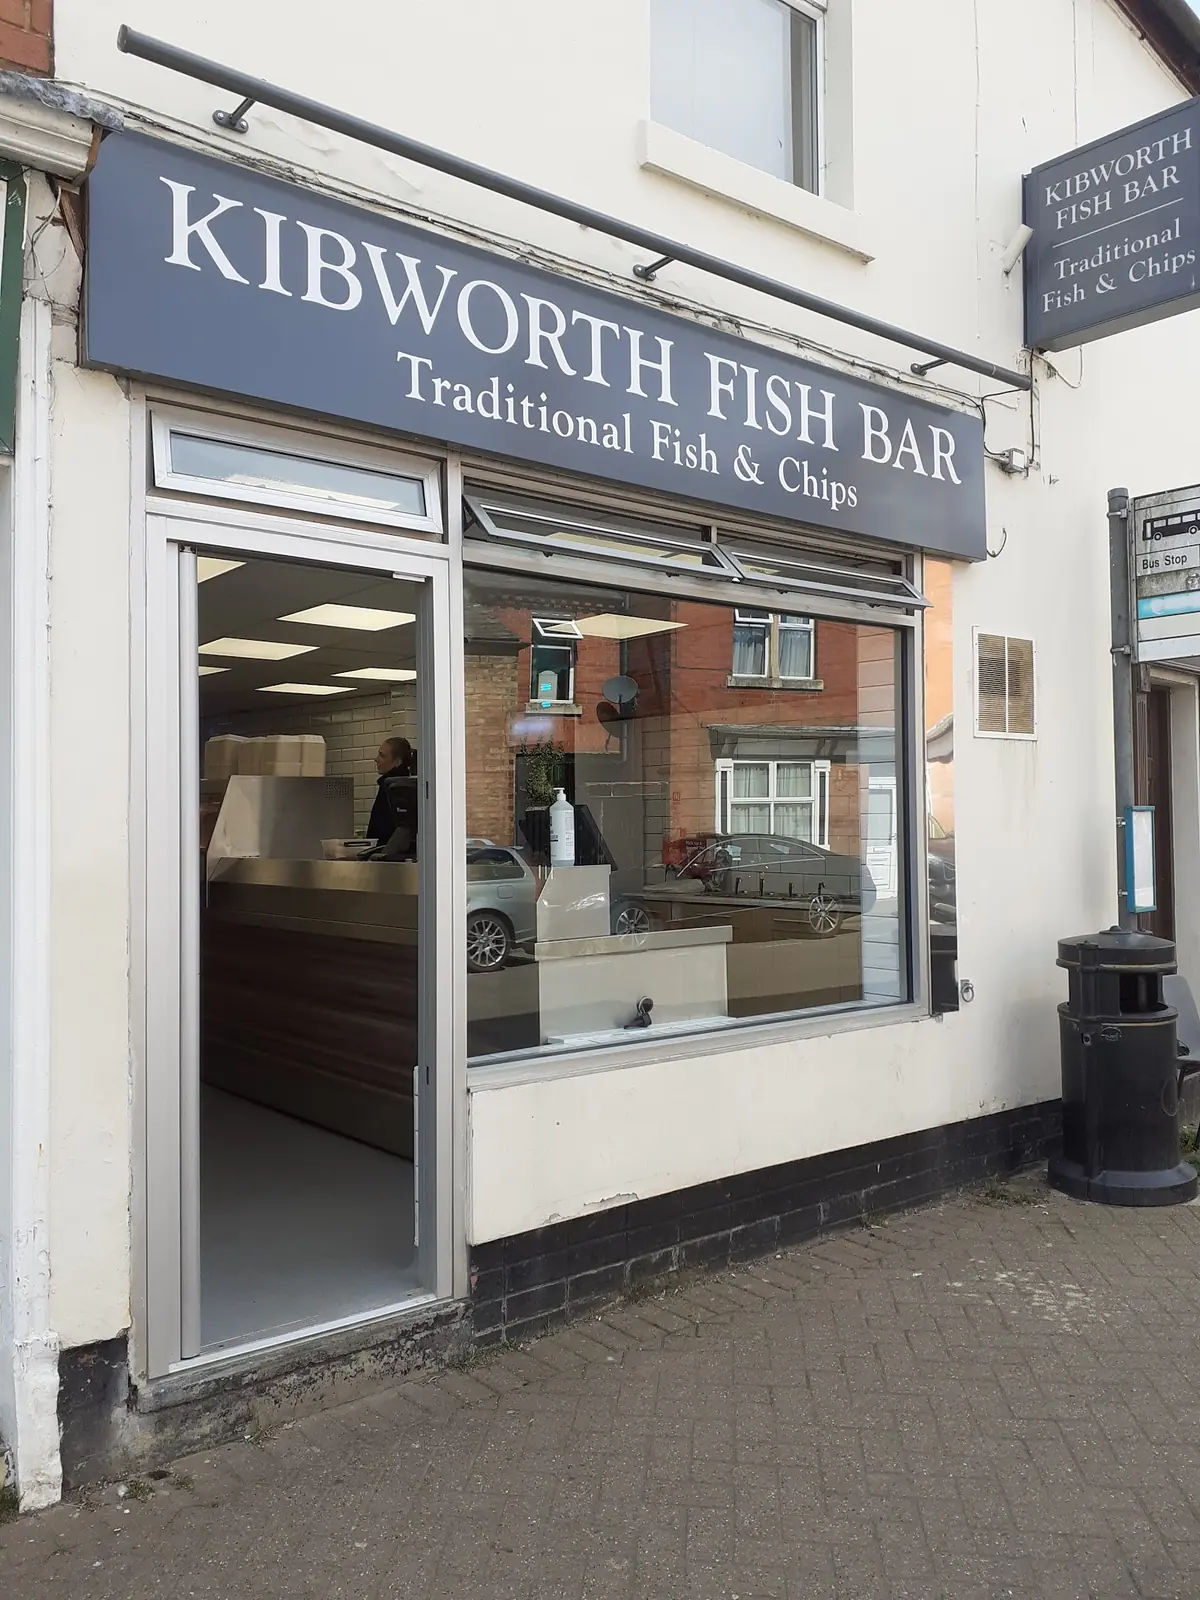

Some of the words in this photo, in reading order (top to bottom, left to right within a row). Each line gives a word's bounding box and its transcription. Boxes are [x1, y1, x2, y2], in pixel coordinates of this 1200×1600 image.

[1045, 127, 1192, 206] KIBWORTH
[1056, 195, 1112, 229] FISH
[1123, 164, 1181, 204] BAR
[1042, 282, 1086, 313] Fish
[1095, 273, 1118, 294] &
[1128, 249, 1196, 282] Chips
[1053, 217, 1181, 280] Traditional
[159, 176, 679, 407] KIBWORTH
[703, 351, 840, 452] FISH
[858, 402, 963, 485] BAR
[396, 351, 635, 454] Traditional
[650, 420, 720, 475] Fish
[734, 444, 765, 485] &
[778, 456, 859, 512] Chips
[1142, 559, 1160, 570] Bus
[1164, 554, 1188, 566] Stop
